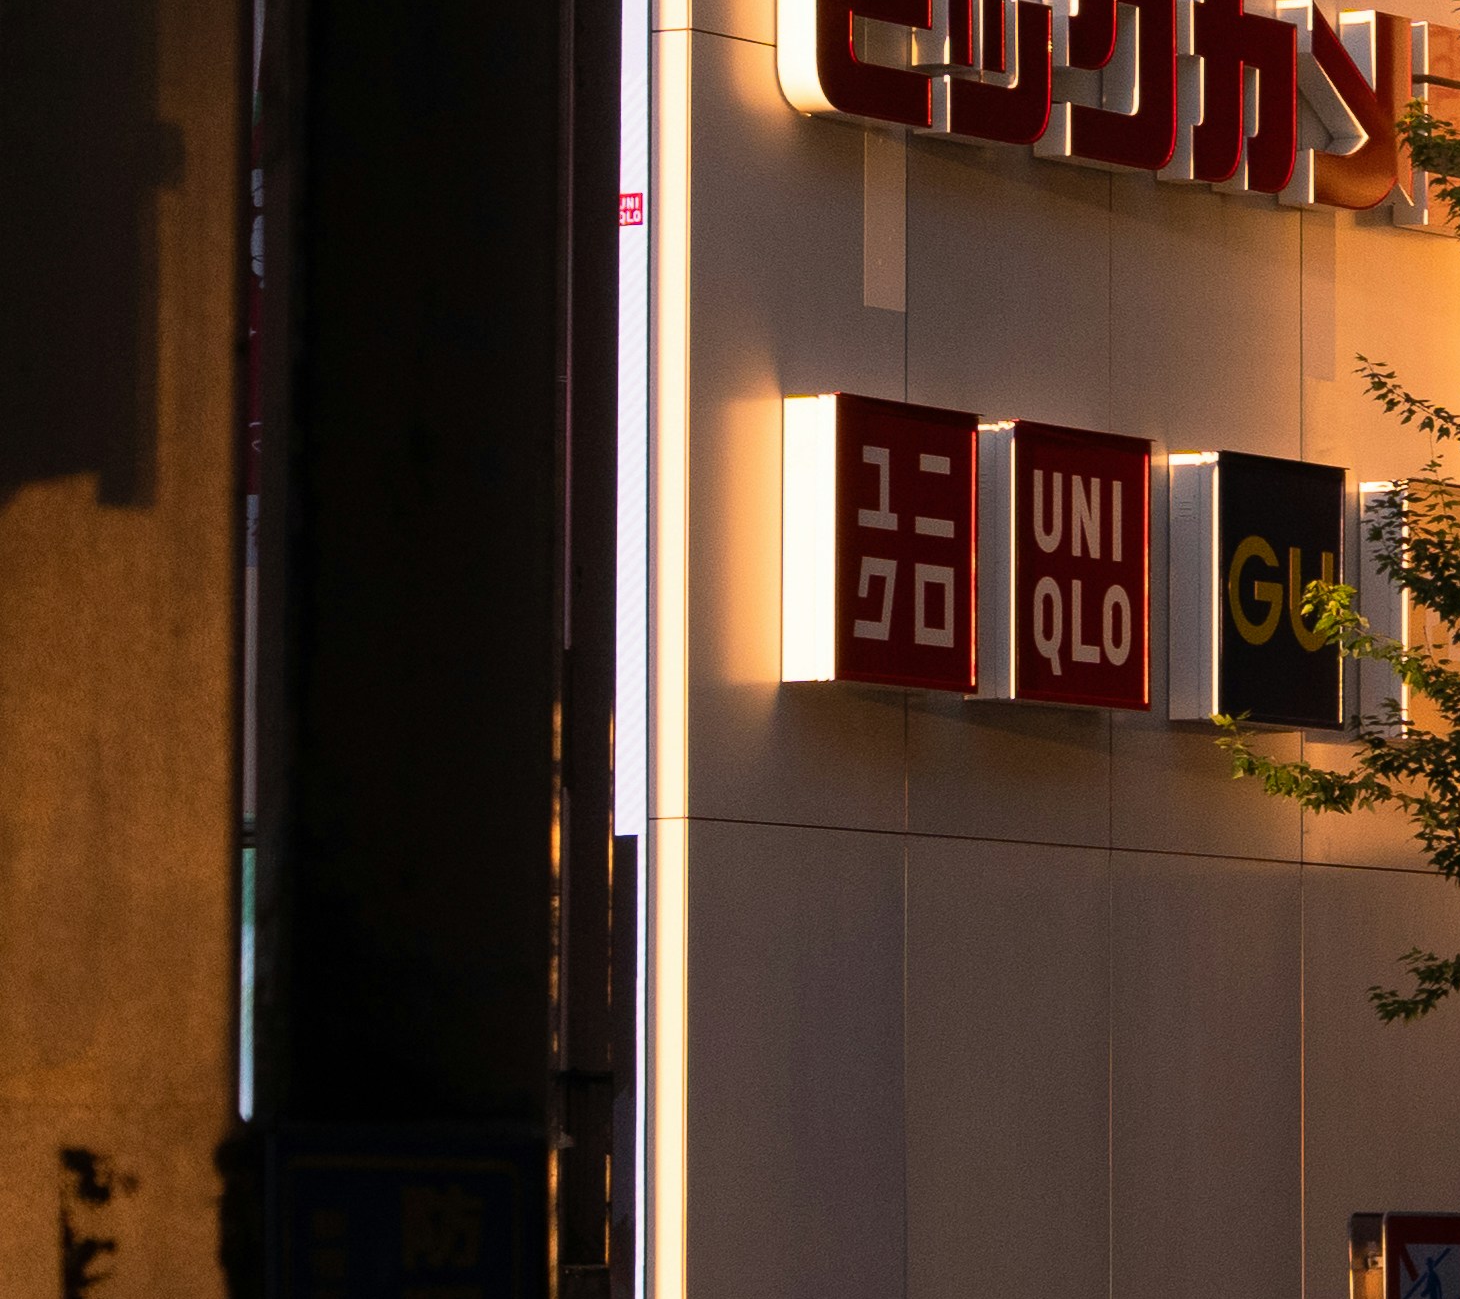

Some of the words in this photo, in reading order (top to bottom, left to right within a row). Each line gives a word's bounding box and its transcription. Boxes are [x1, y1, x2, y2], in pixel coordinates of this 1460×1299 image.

[1031, 468, 1123, 563] UNI
[1031, 575, 1132, 676] QLO
[1227, 535, 1336, 652] GU
